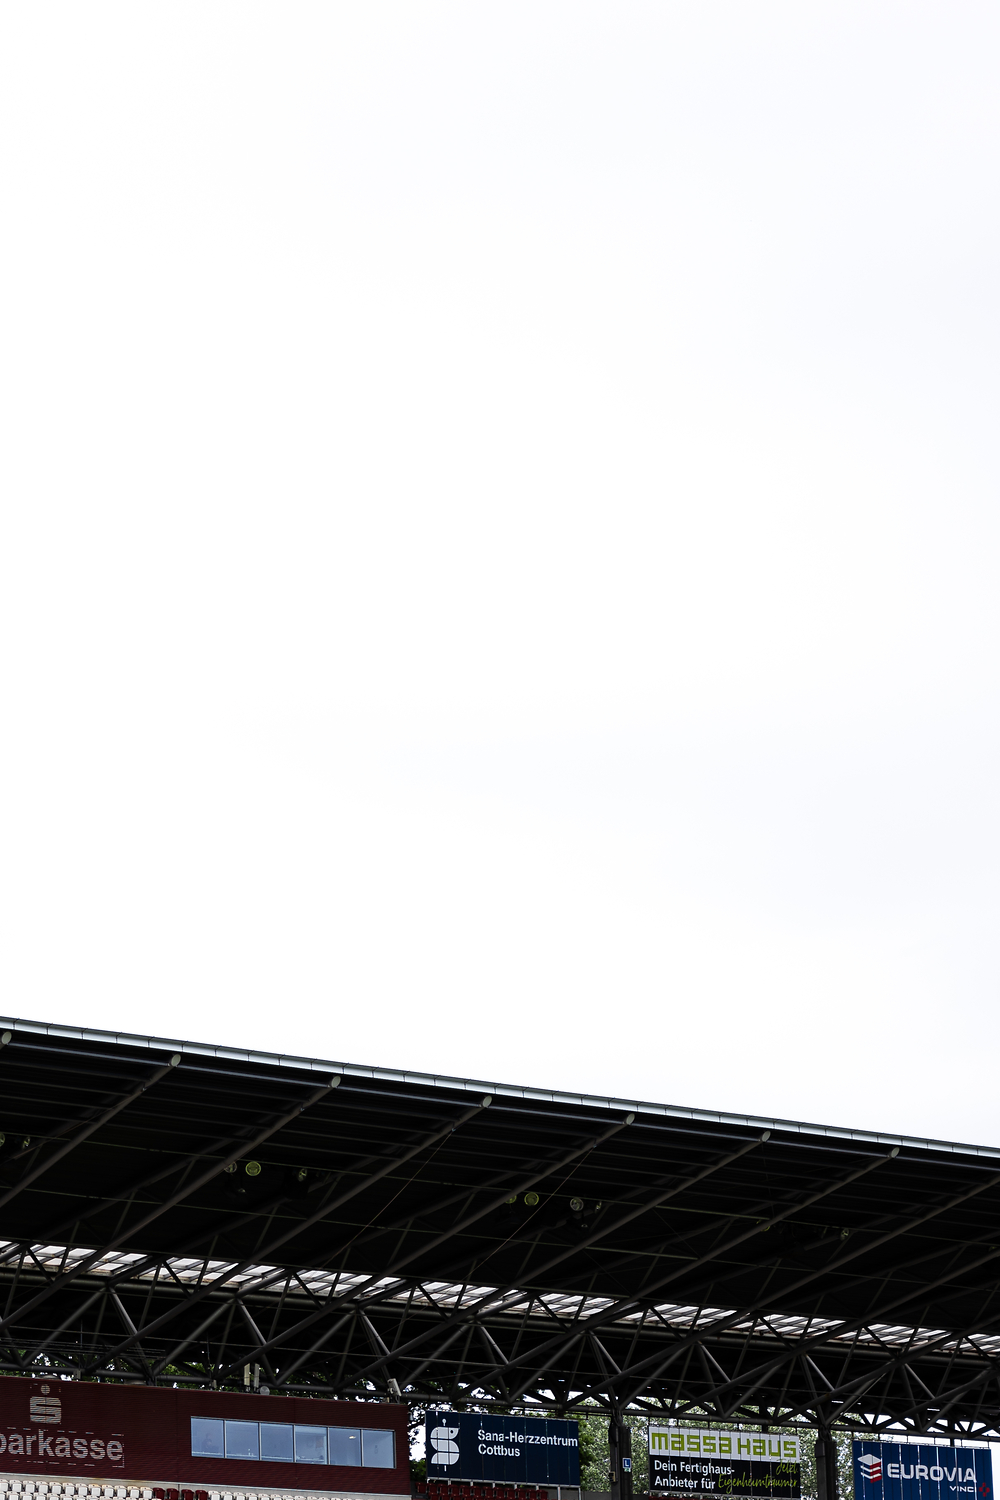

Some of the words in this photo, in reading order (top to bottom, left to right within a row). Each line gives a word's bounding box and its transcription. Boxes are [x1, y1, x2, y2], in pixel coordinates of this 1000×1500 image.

[477, 1430, 578, 1447] Sana-Herzzentrum
[478, 1443, 521, 1457] Cottbus
[654, 1460, 677, 1472] Dein
[680, 1462, 735, 1476] Fertighaus-
[887, 1463, 977, 1483] EUROVIA
[654, 1476, 699, 1489] Anbieter
[701, 1478, 716, 1489] für
